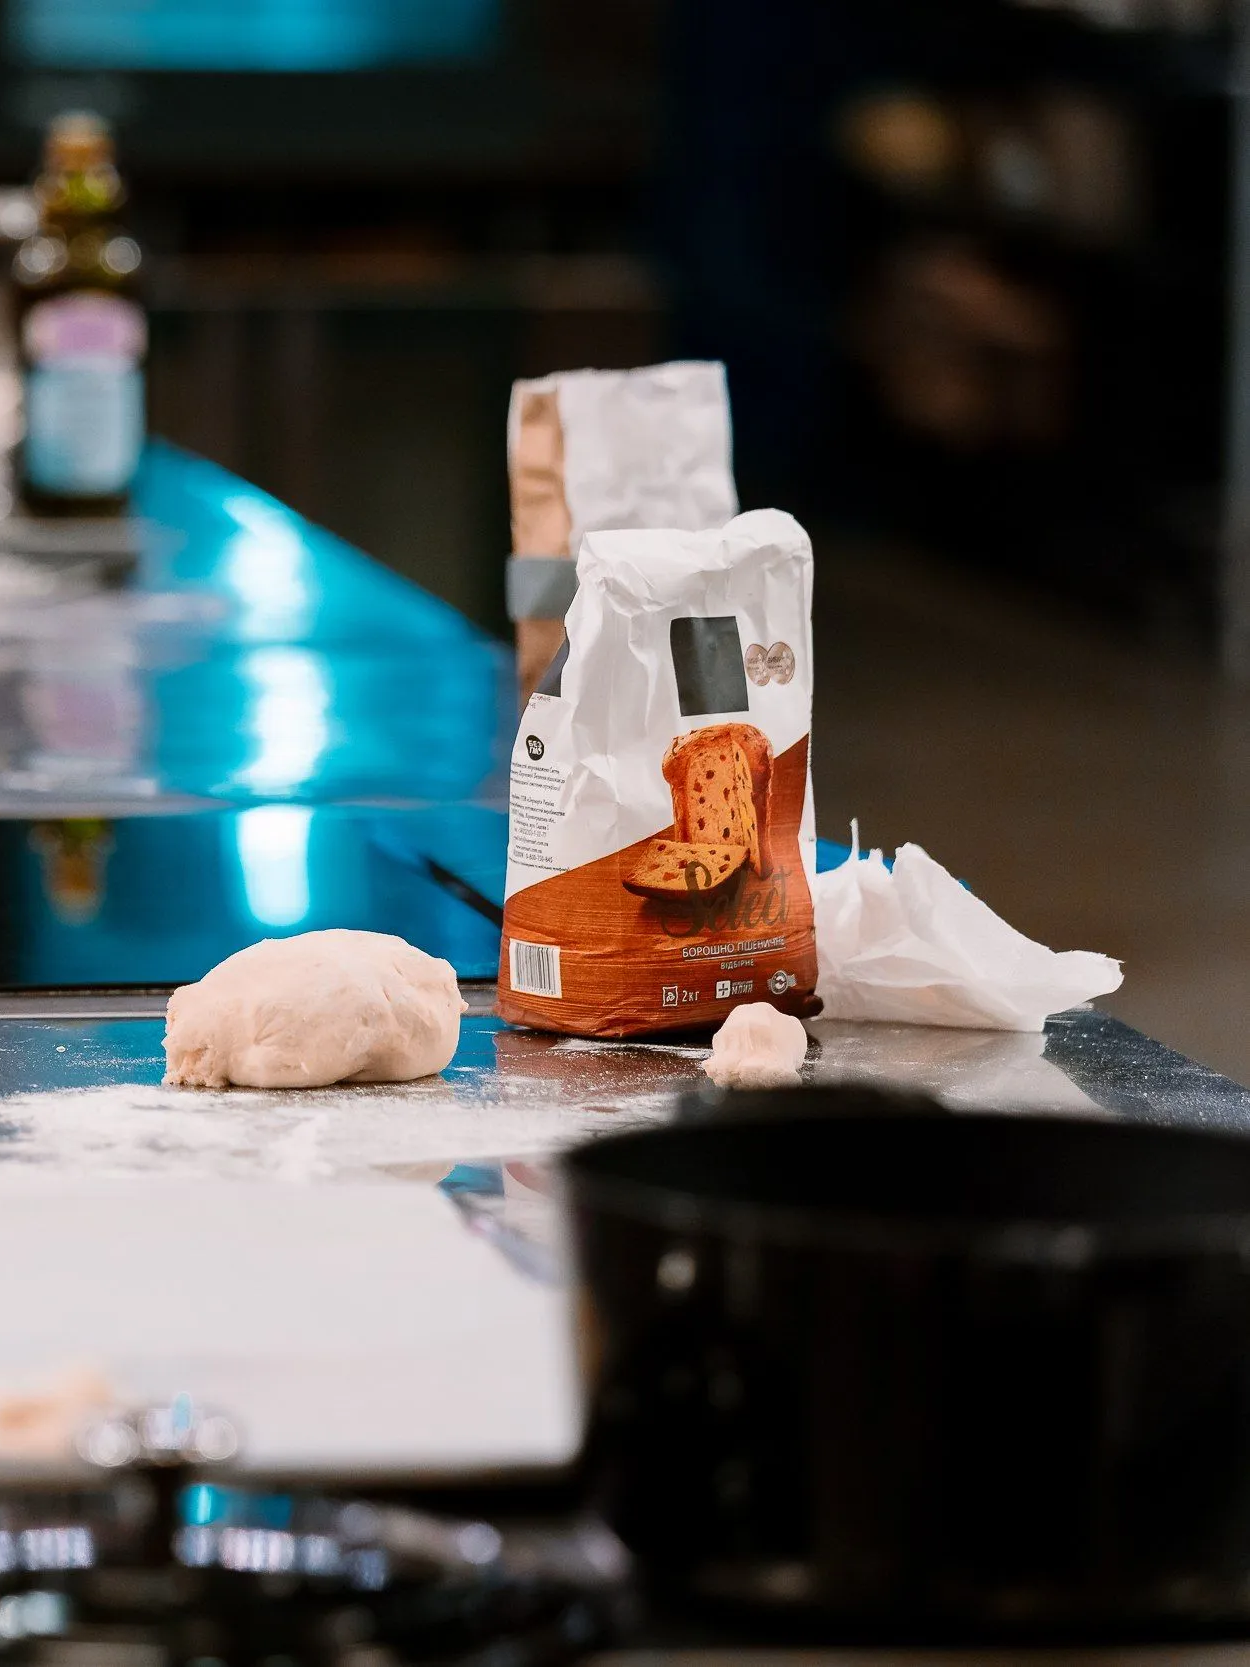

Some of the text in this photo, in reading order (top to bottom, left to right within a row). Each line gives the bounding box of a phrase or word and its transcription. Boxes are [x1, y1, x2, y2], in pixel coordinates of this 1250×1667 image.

[527, 739, 542, 748] БЕЗ
[660, 861, 792, 938] Select
[682, 936, 786, 958] БОРОШНО ПШЕНИЧНЕ
[720, 959, 755, 970] ВІДБІРНЕ
